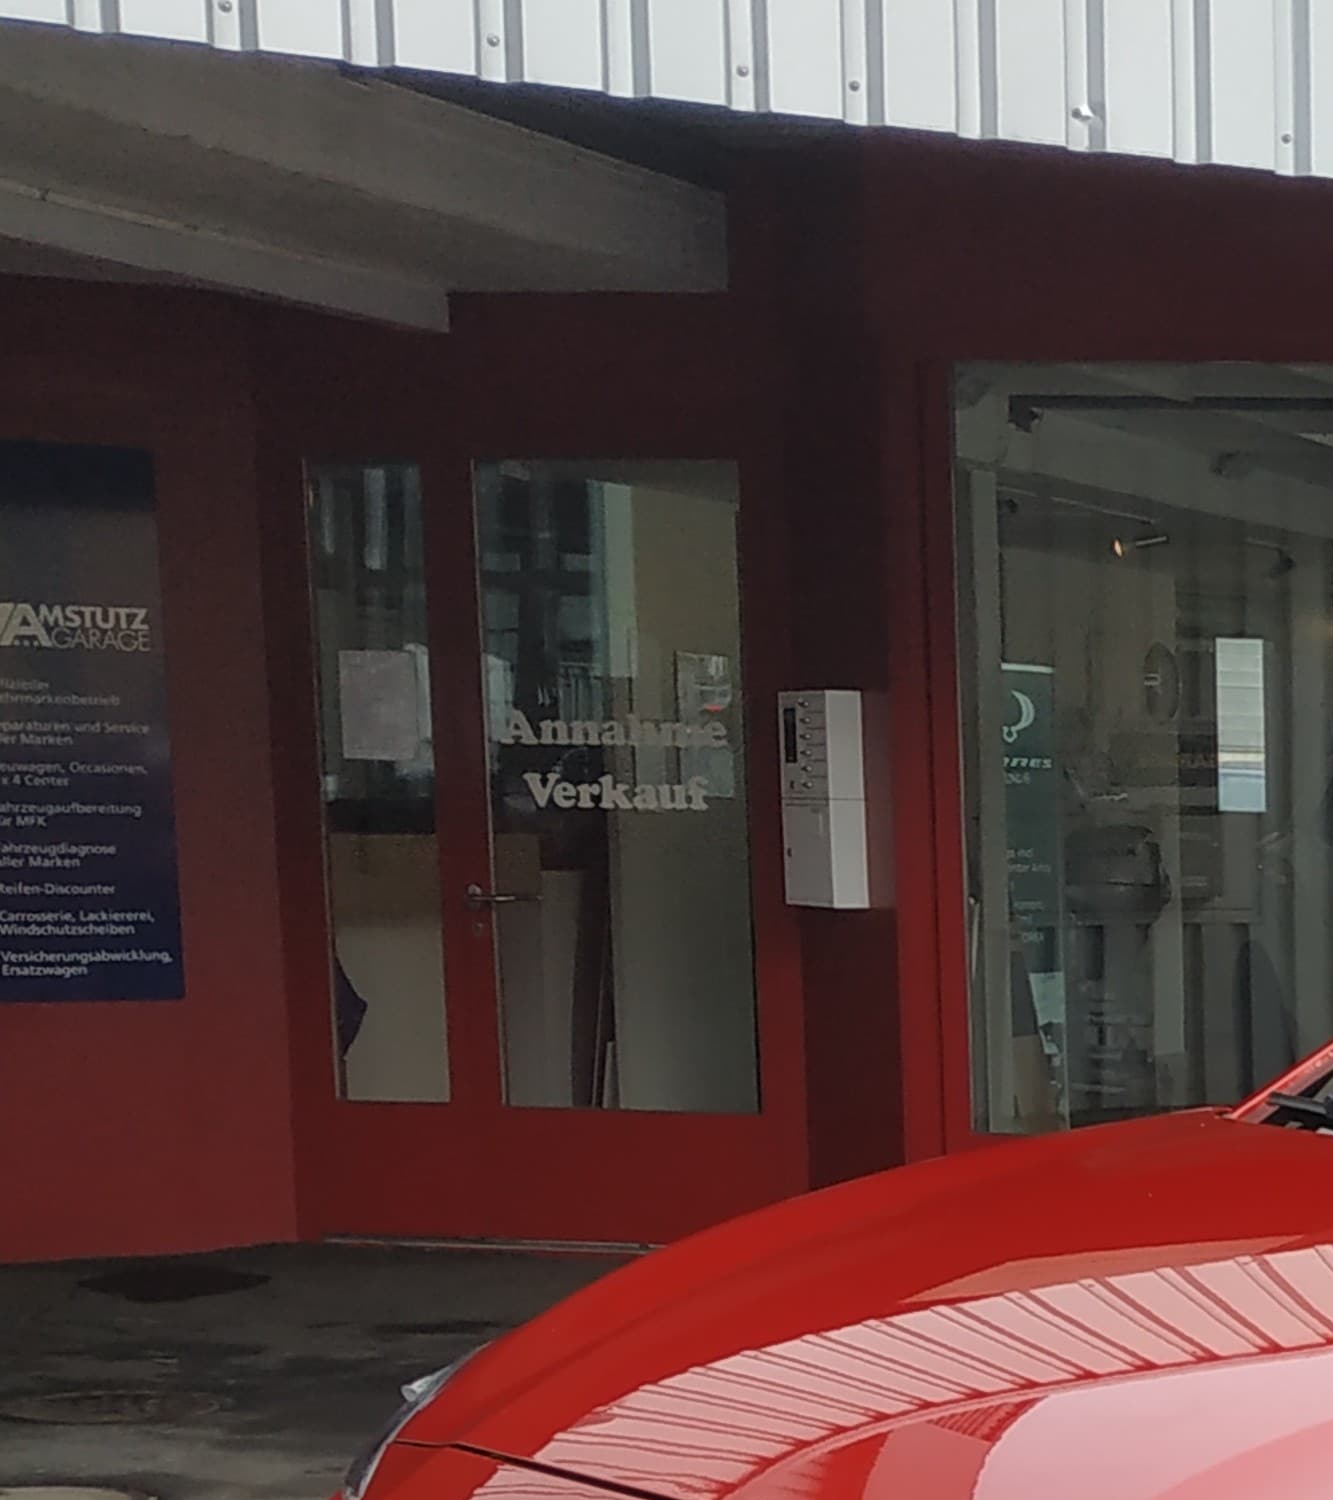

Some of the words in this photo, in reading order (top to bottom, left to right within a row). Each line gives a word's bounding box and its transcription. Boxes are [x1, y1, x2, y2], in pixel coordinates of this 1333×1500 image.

[0, 602, 150, 647] AMSTUTZ
[51, 627, 151, 652] GARAGE
[500, 707, 728, 748] Annahme
[24, 774, 70, 786] Center
[522, 771, 709, 811] Verkauf
[28, 856, 81, 868] Marken
[2, 965, 88, 978] Ersatzwagen
